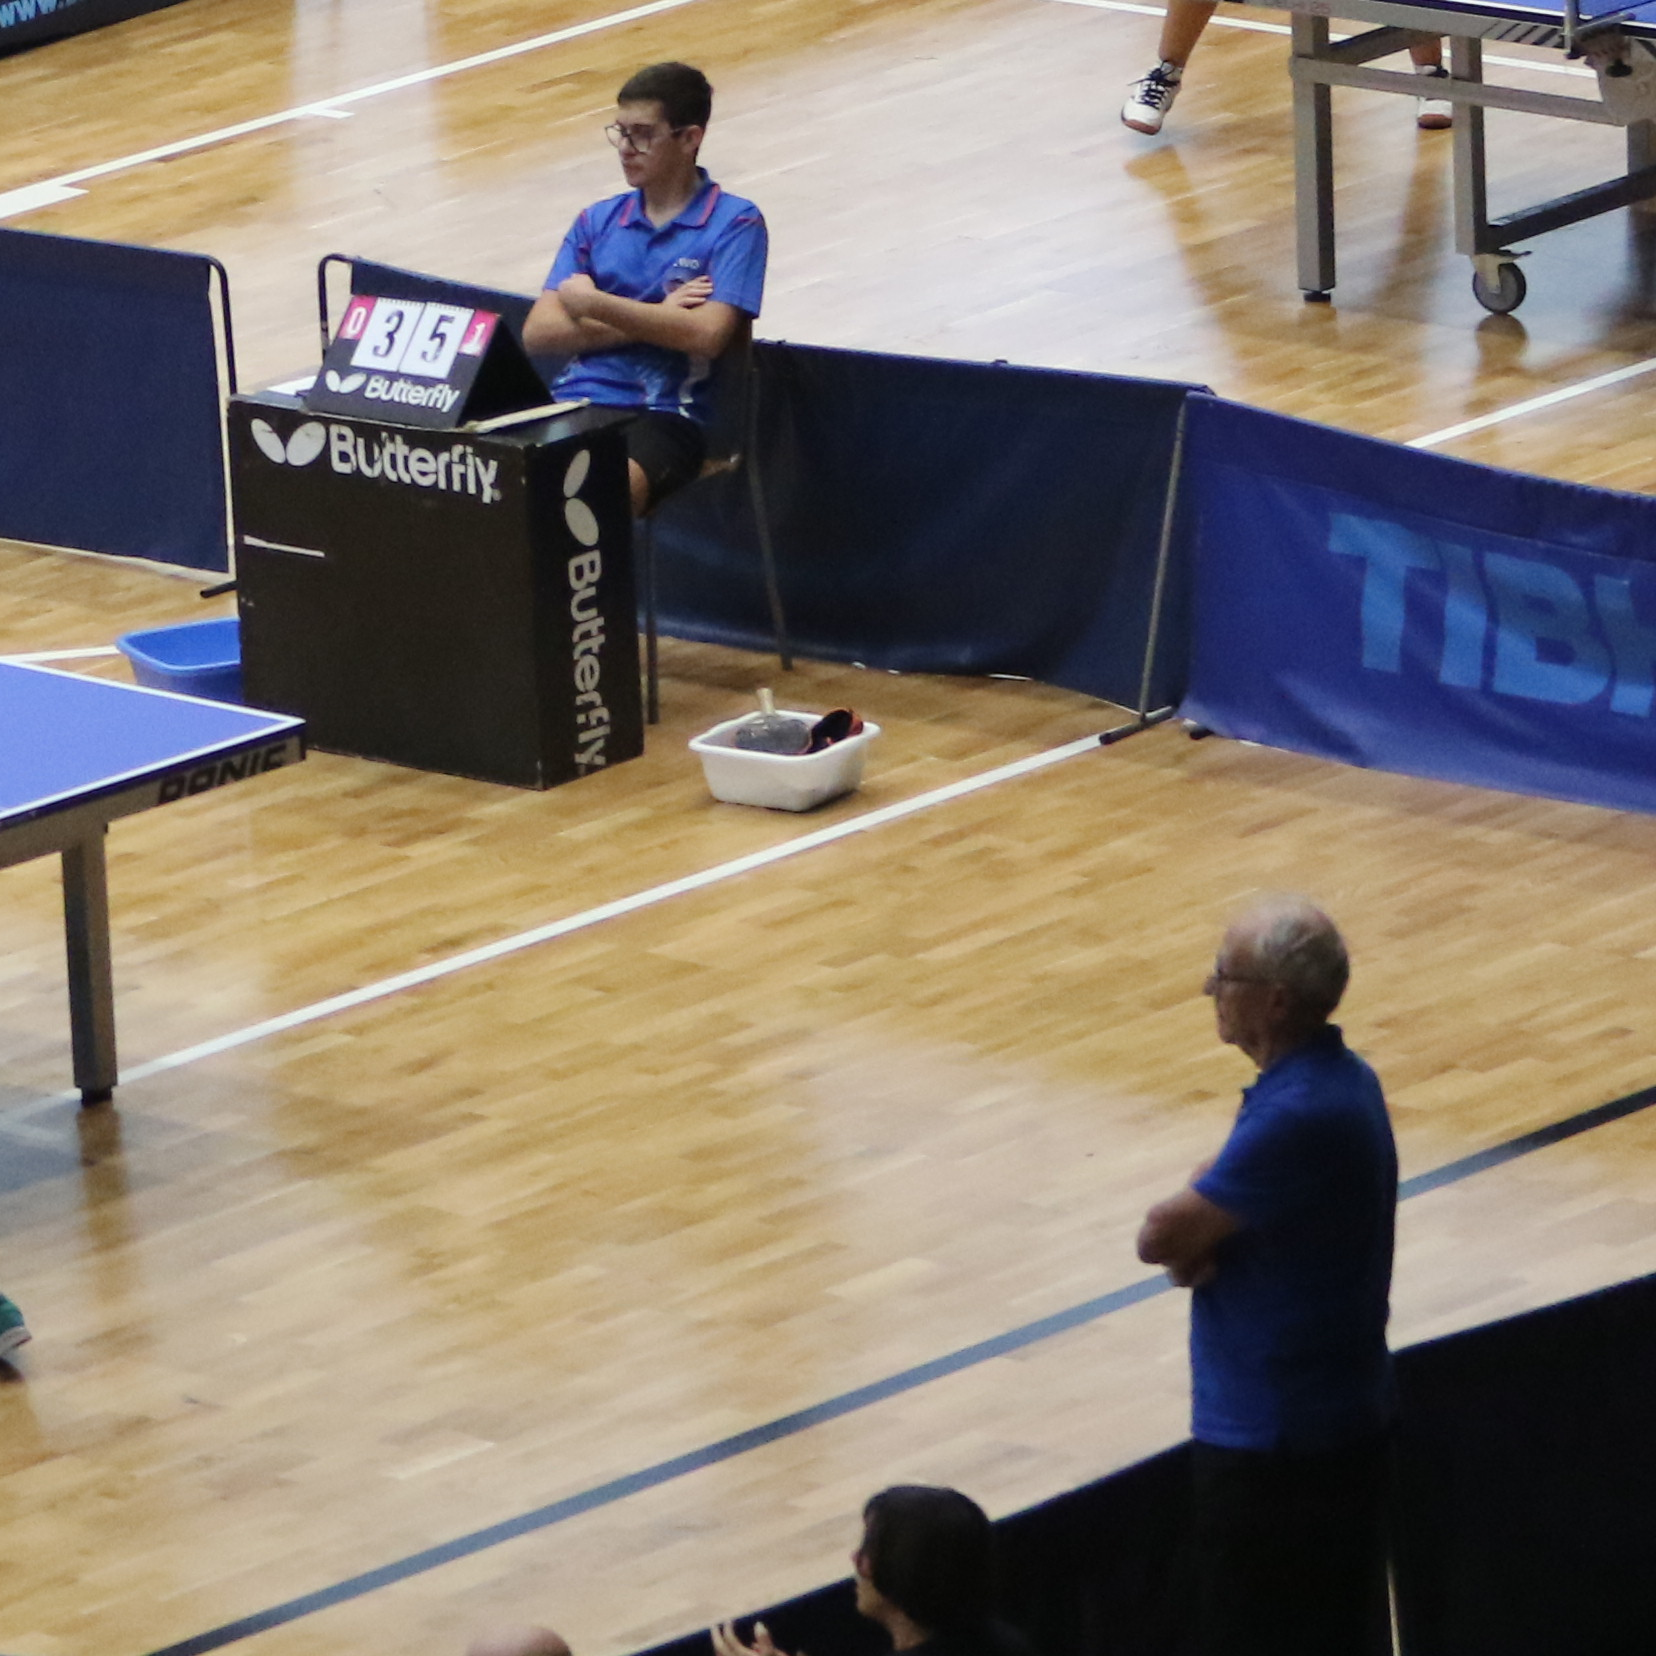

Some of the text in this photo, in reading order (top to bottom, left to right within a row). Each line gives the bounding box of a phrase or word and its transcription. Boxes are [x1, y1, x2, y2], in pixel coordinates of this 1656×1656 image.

[347, 306, 486, 363] 0 3 5 1
[365, 375, 459, 413] Butterfly
[329, 425, 500, 504] Butterfly
[568, 547, 608, 774] Butterfly
[158, 745, 287, 805] DONIC
